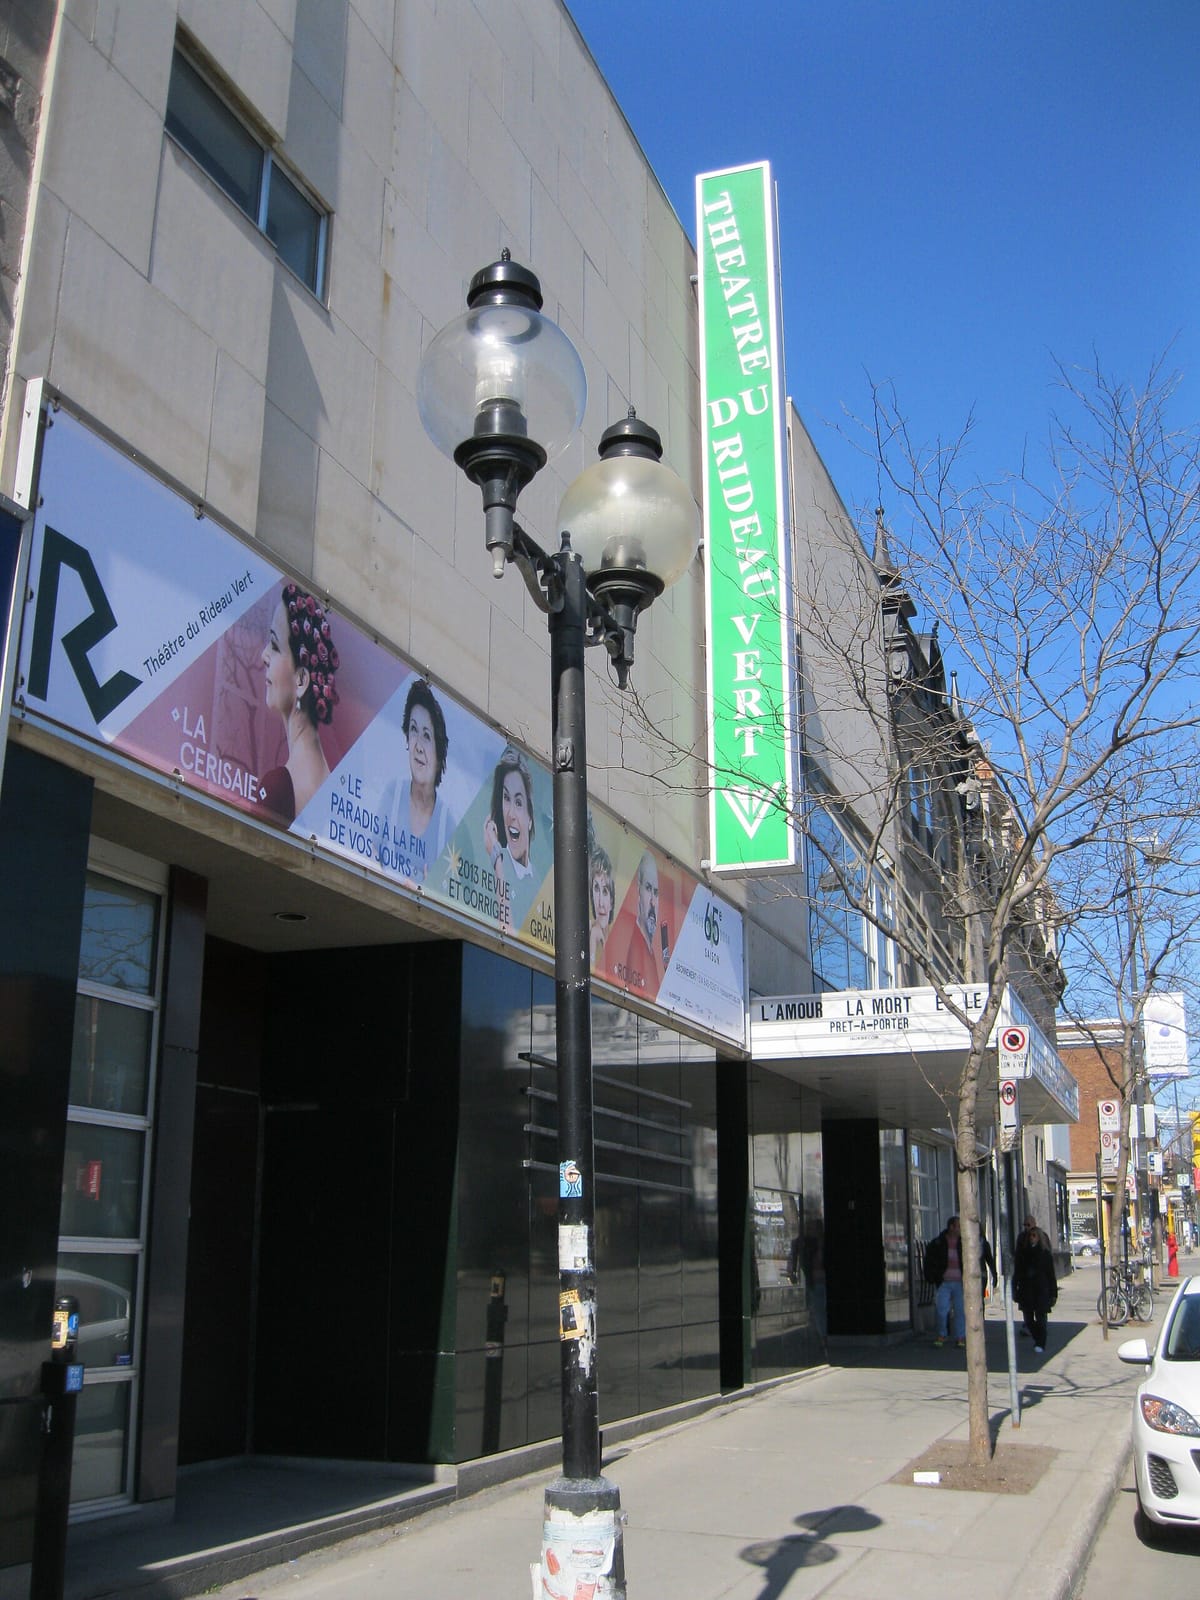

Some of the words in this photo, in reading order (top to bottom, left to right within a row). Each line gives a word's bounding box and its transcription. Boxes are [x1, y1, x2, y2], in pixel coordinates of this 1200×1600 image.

[703, 191, 771, 376] THEATRE
[707, 384, 769, 428] DU
[712, 433, 776, 599] RIDEAU
[143, 635, 186, 677] Théâtre
[186, 621, 200, 640] du
[199, 592, 233, 627] Rideau
[231, 570, 254, 596] Vert
[729, 611, 764, 758] VERT
[182, 706, 206, 744] LA
[180, 741, 258, 803] CERISAIE
[347, 774, 362, 799] LE
[329, 819, 346, 846] DE
[349, 828, 373, 858] VOS
[375, 843, 411, 877] JOURS
[330, 791, 380, 835] PARADIS
[382, 815, 390, 841] À
[393, 825, 407, 850] LA
[409, 834, 426, 860] FIN
[448, 877, 461, 900] ET
[462, 886, 510, 925] CORRIGÉE
[457, 857, 480, 885] 2013
[481, 869, 510, 901] REVUE
[530, 919, 555, 946] GRAN
[541, 900, 553, 922] LA
[761, 1001, 823, 1021] L'AMOUR
[847, 1000, 864, 1016] LA
[872, 996, 911, 1015] MORT
[936, 994, 953, 1010] E
[964, 992, 982, 1009] LE
[830, 1017, 909, 1032] PRET-A-PORTER
